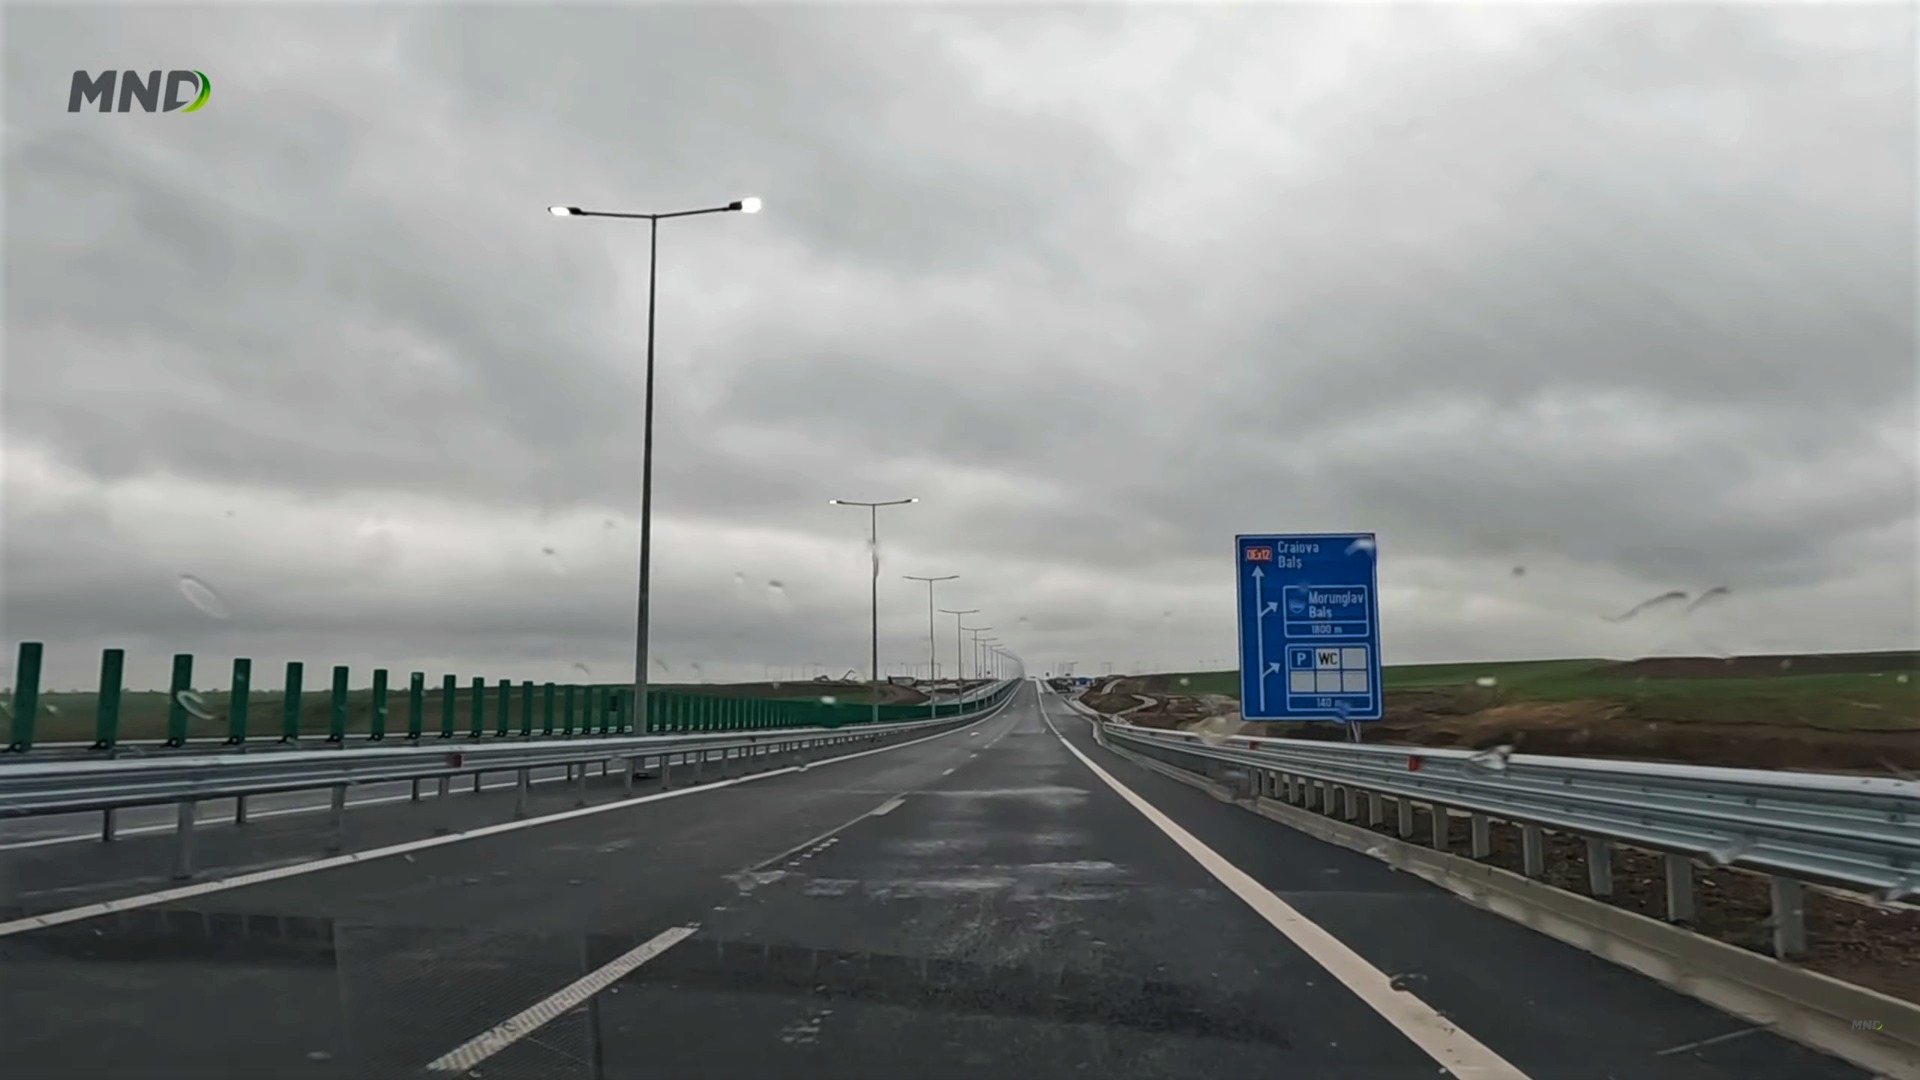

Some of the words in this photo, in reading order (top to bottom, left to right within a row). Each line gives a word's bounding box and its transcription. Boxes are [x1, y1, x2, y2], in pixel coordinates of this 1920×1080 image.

[1277, 540, 1320, 554] Craiova
[1308, 590, 1364, 607] Morunglav
[1333, 626, 1343, 634] m
[1296, 652, 1307, 666] P
[1318, 652, 1338, 665] WC
